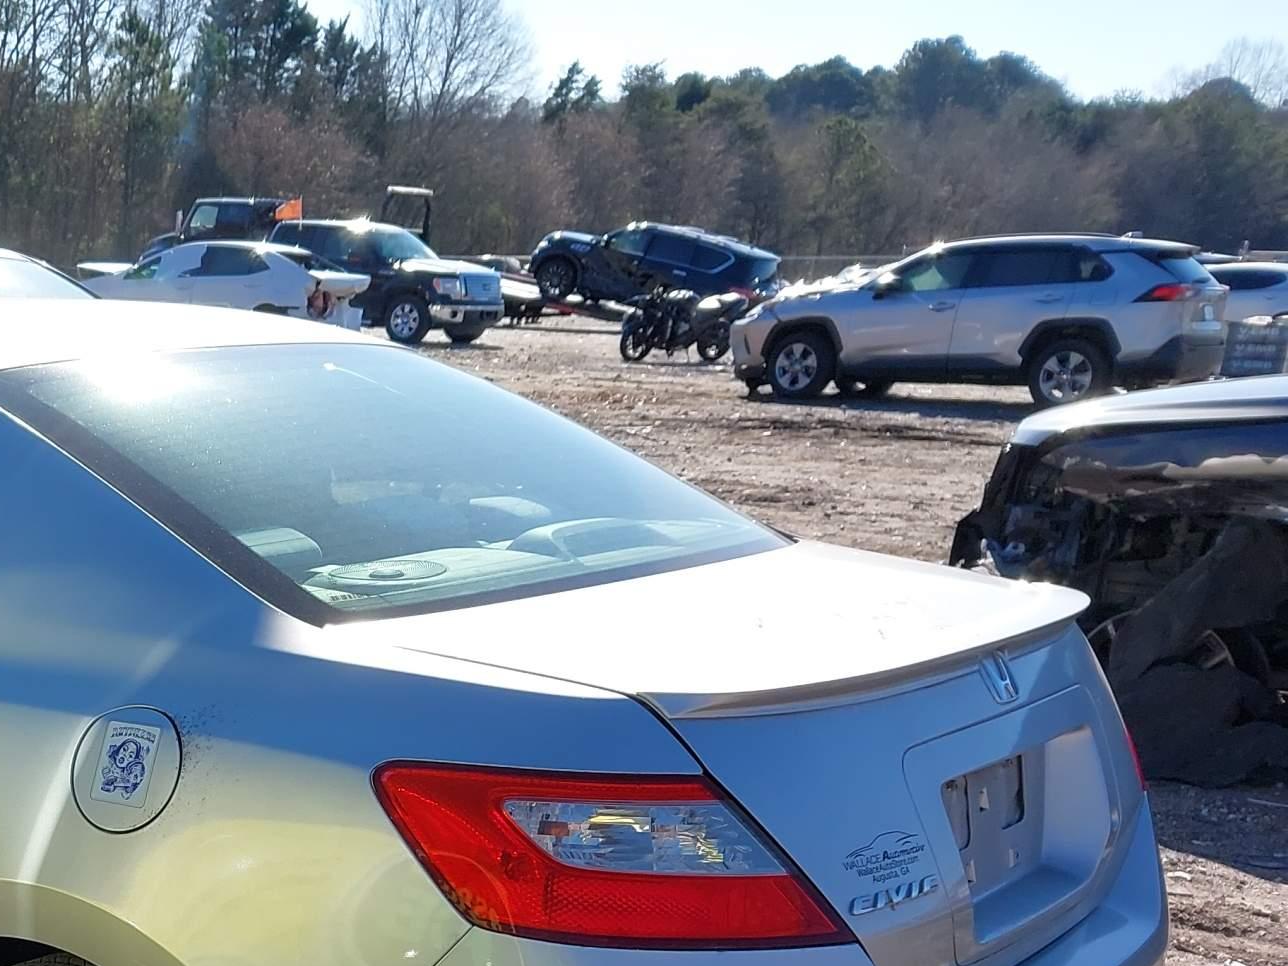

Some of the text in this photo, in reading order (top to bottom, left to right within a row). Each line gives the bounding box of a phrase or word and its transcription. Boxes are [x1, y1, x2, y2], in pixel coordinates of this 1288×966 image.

[842, 853, 883, 872] WALLACE
[899, 867, 911, 877] GA
[848, 874, 939, 916] CIVIC
